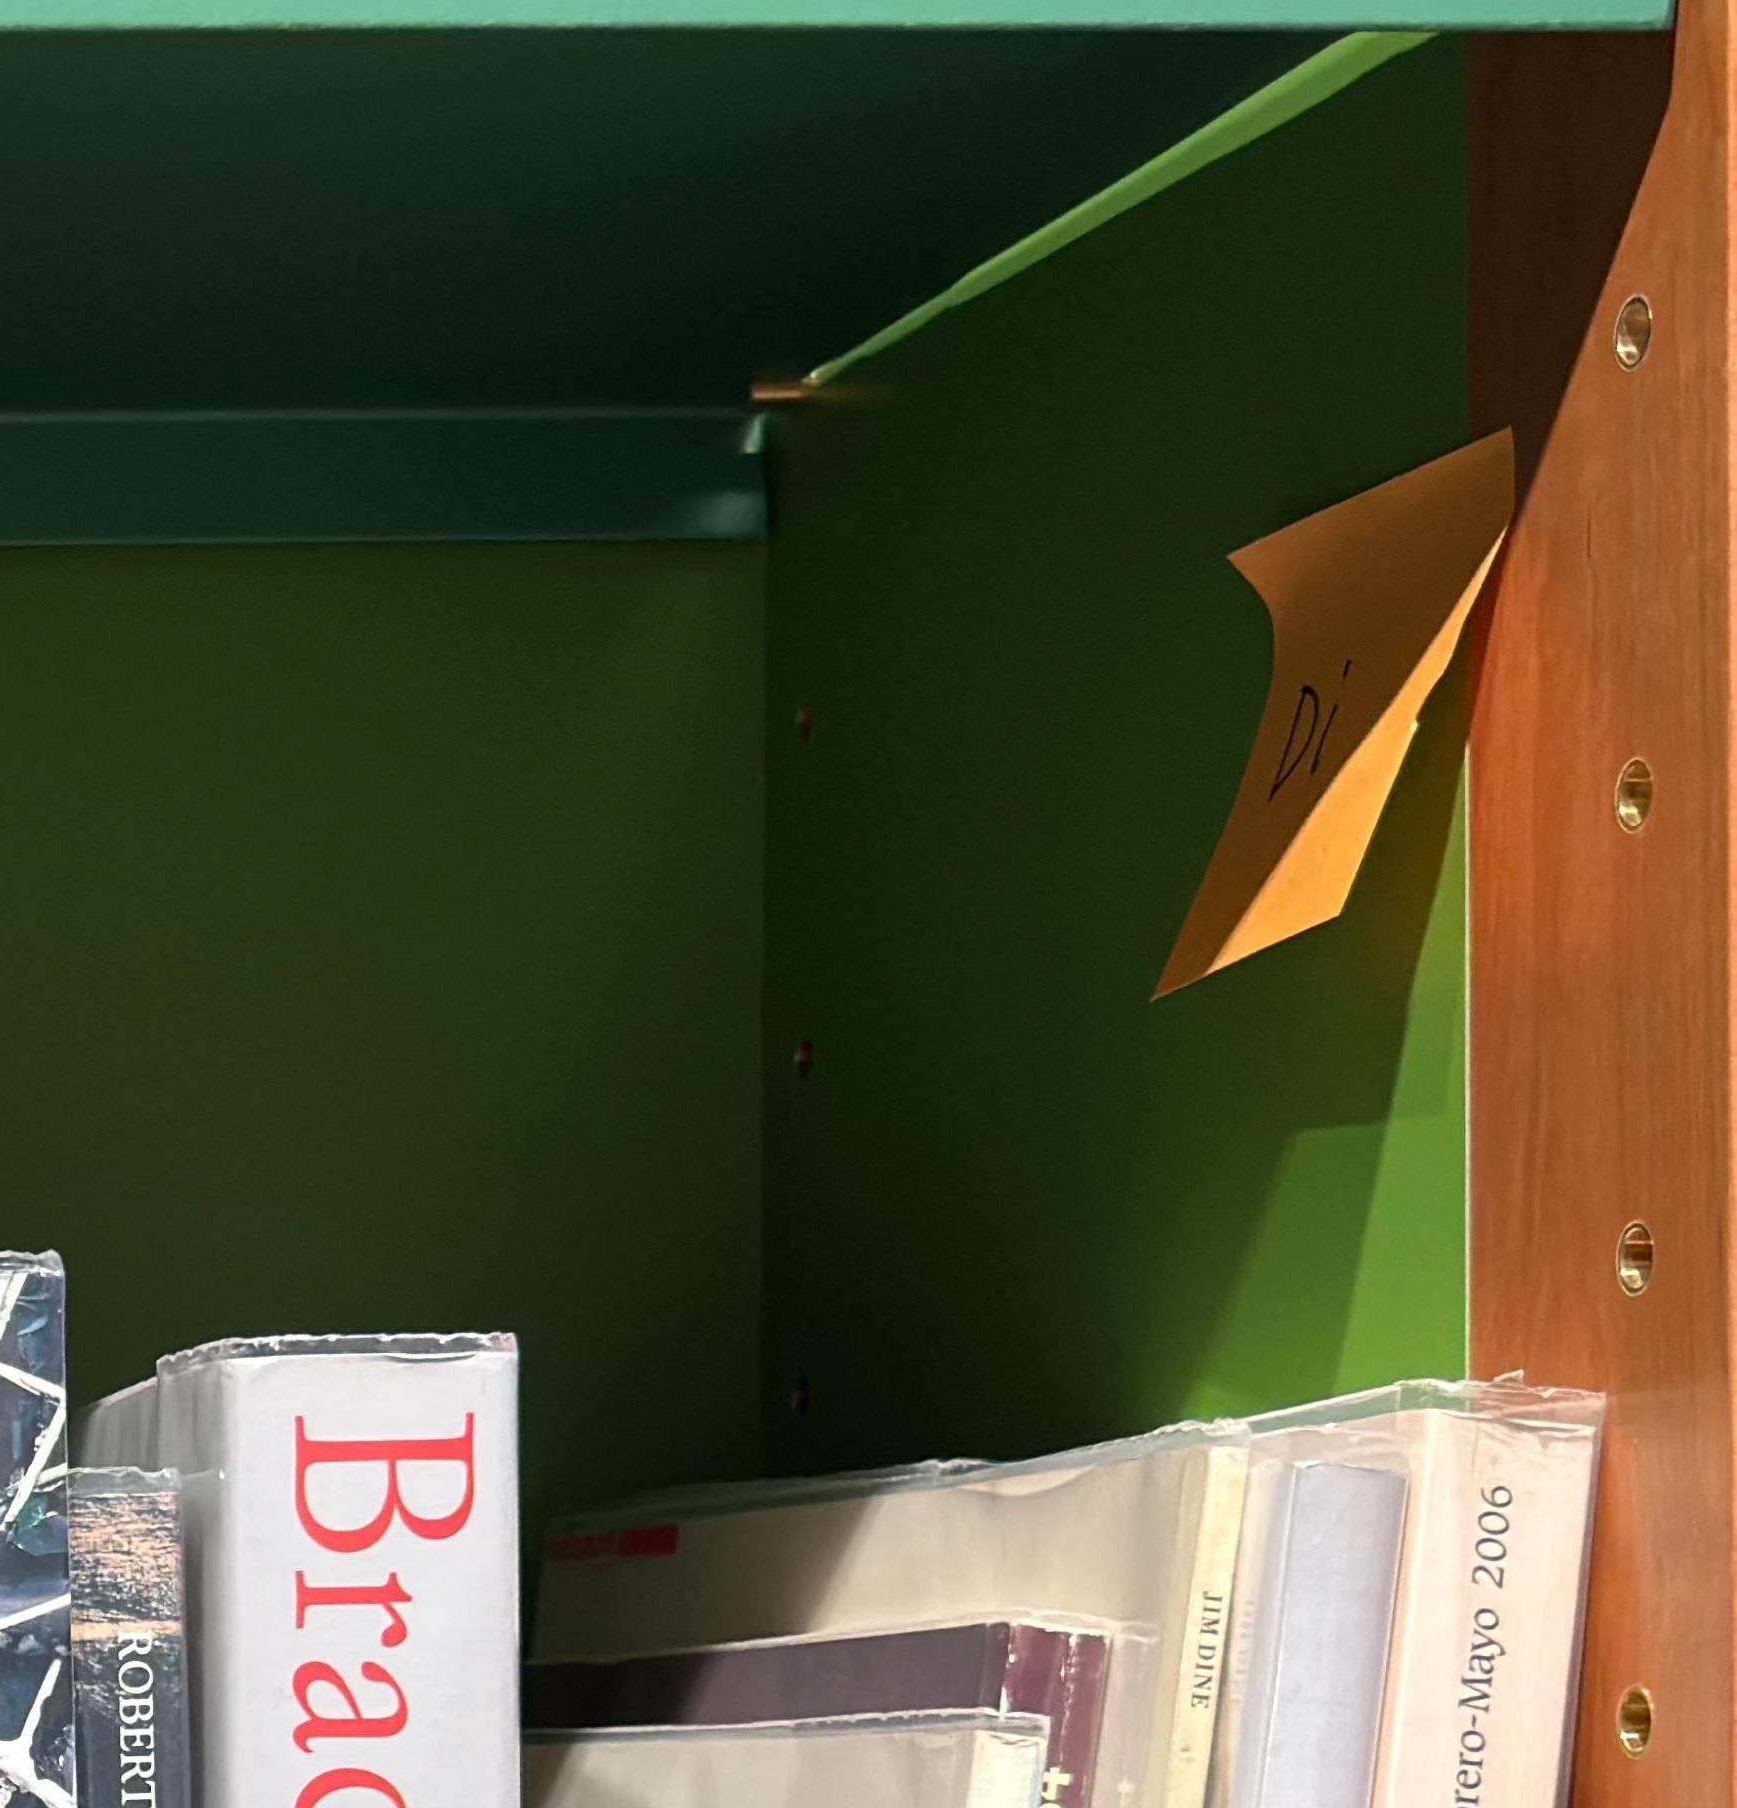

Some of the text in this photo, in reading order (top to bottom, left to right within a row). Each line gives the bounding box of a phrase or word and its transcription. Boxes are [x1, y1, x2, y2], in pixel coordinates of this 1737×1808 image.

[1268, 660, 1353, 803] Di
[1468, 1485, 1513, 1589] 2006
[1189, 1591, 1224, 1709] JIM DINE
